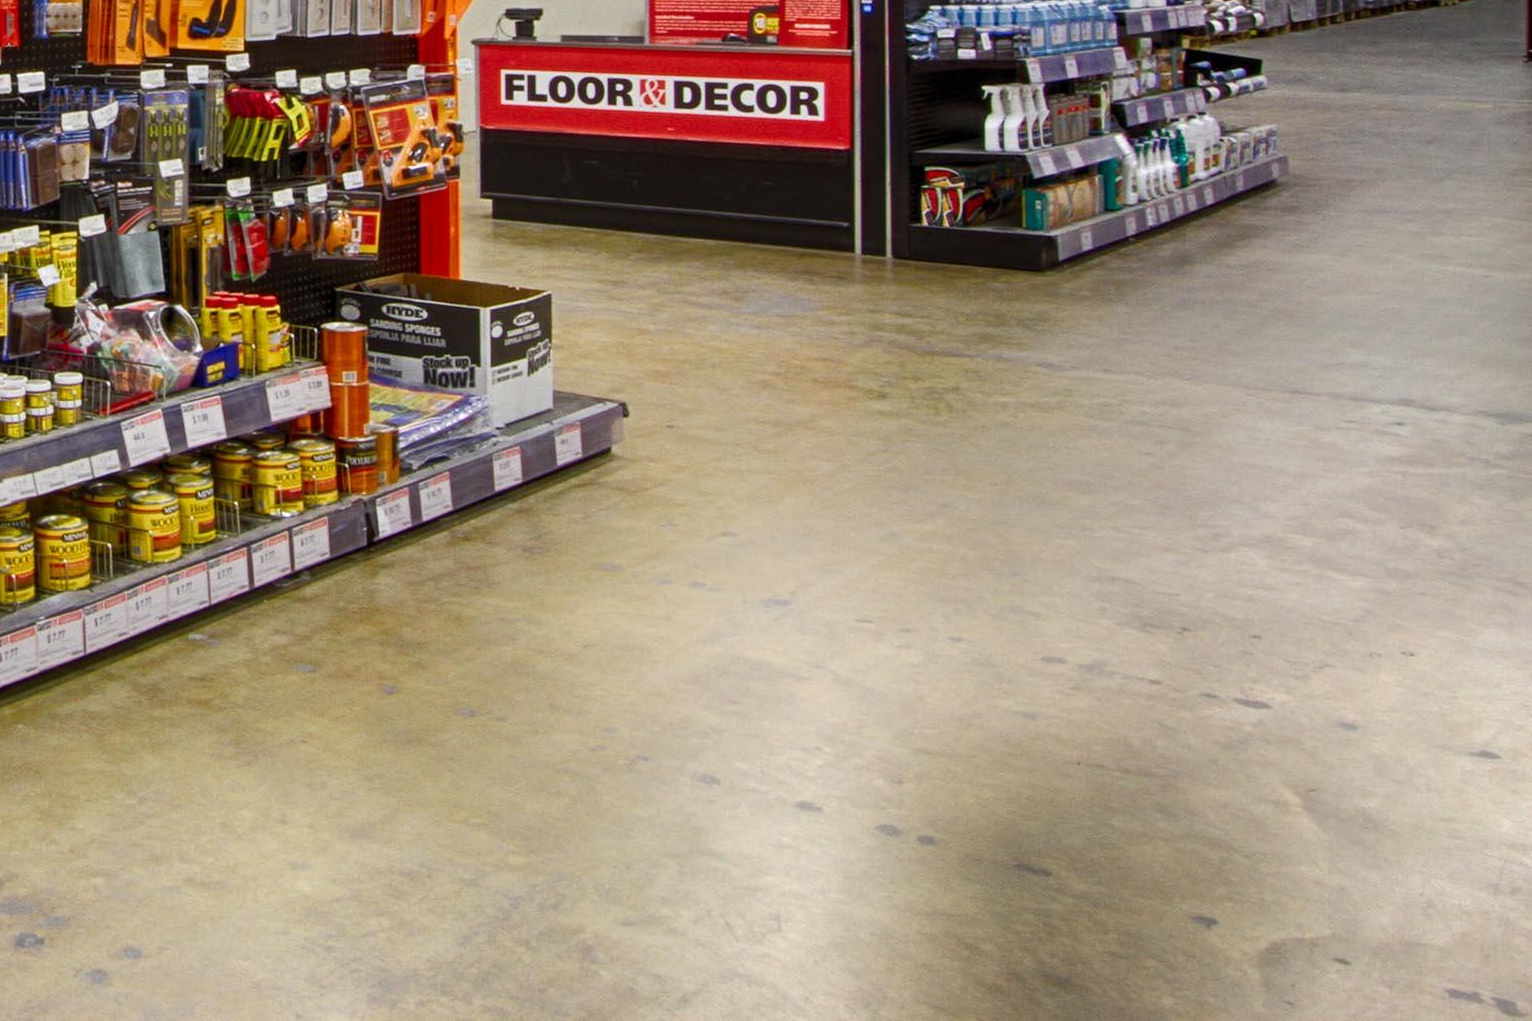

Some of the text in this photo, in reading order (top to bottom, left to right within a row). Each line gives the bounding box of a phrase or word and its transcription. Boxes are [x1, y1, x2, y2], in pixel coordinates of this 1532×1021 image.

[504, 73, 819, 116] FLOOR & DECOR
[386, 306, 424, 319] HYDE
[369, 318, 441, 336] SANDING SPONGES
[369, 330, 399, 342] SPONJA
[422, 357, 468, 370] Stock up
[423, 367, 476, 389] Now!
